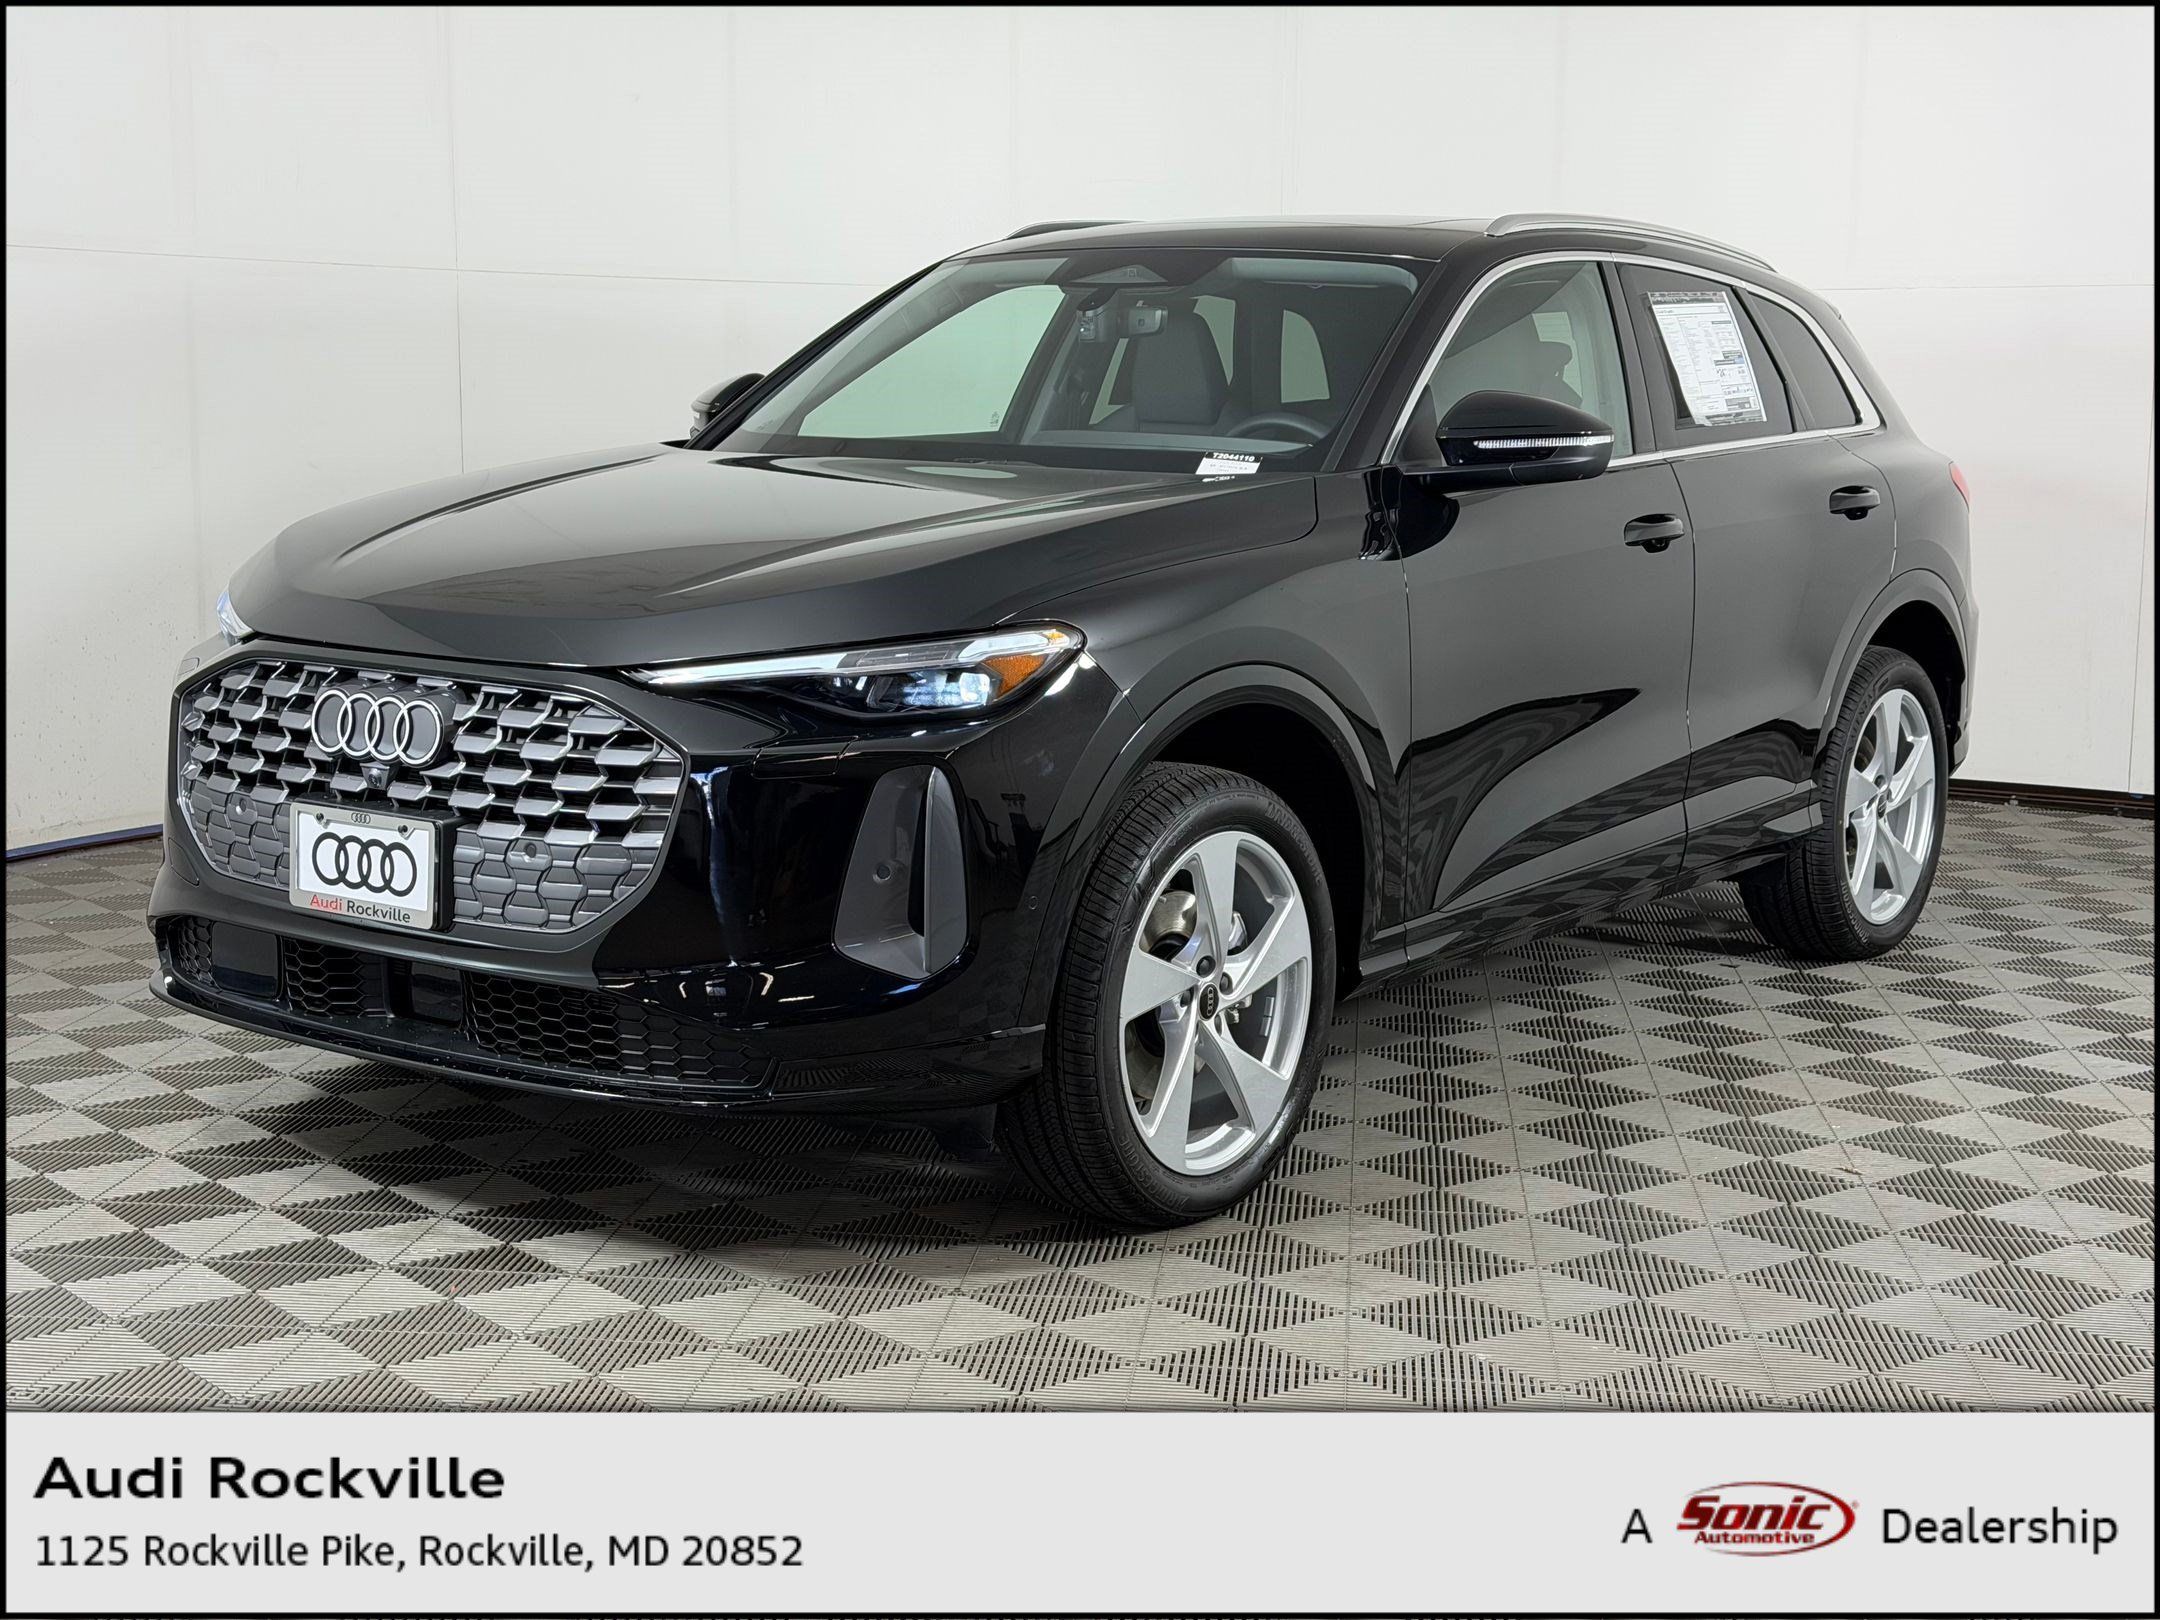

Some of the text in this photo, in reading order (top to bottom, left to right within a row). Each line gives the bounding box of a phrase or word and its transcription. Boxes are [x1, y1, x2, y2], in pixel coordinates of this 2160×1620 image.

[1213, 452, 1255, 462] T2044110
[310, 894, 411, 923] Audi Rockville
